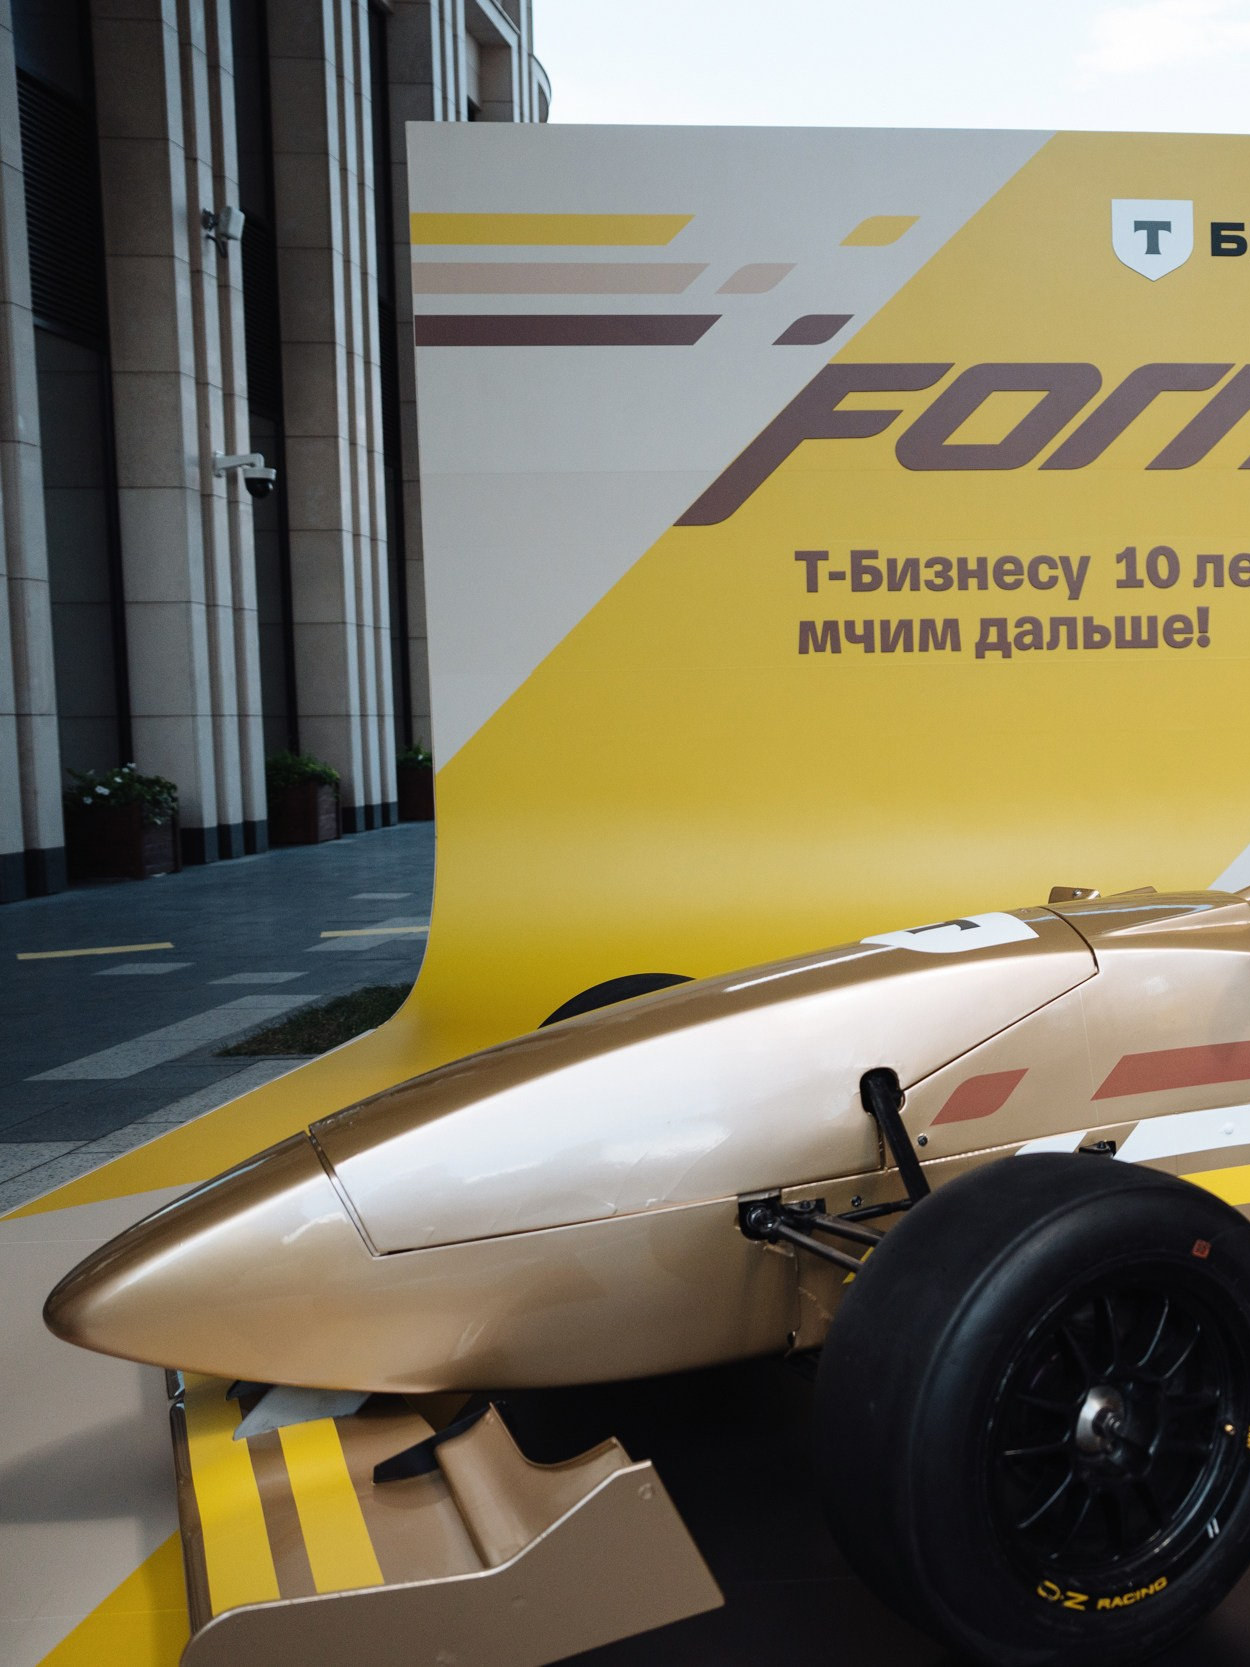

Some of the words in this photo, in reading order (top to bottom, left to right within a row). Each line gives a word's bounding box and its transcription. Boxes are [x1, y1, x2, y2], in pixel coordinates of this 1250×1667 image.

[1133, 220, 1172, 255] Т
[795, 549, 1091, 600] Т-Бизнесу
[1115, 546, 1181, 590] 10
[798, 618, 962, 654] мчим
[975, 606, 1212, 659] дальше!
[1096, 1576, 1169, 1611] RACING
